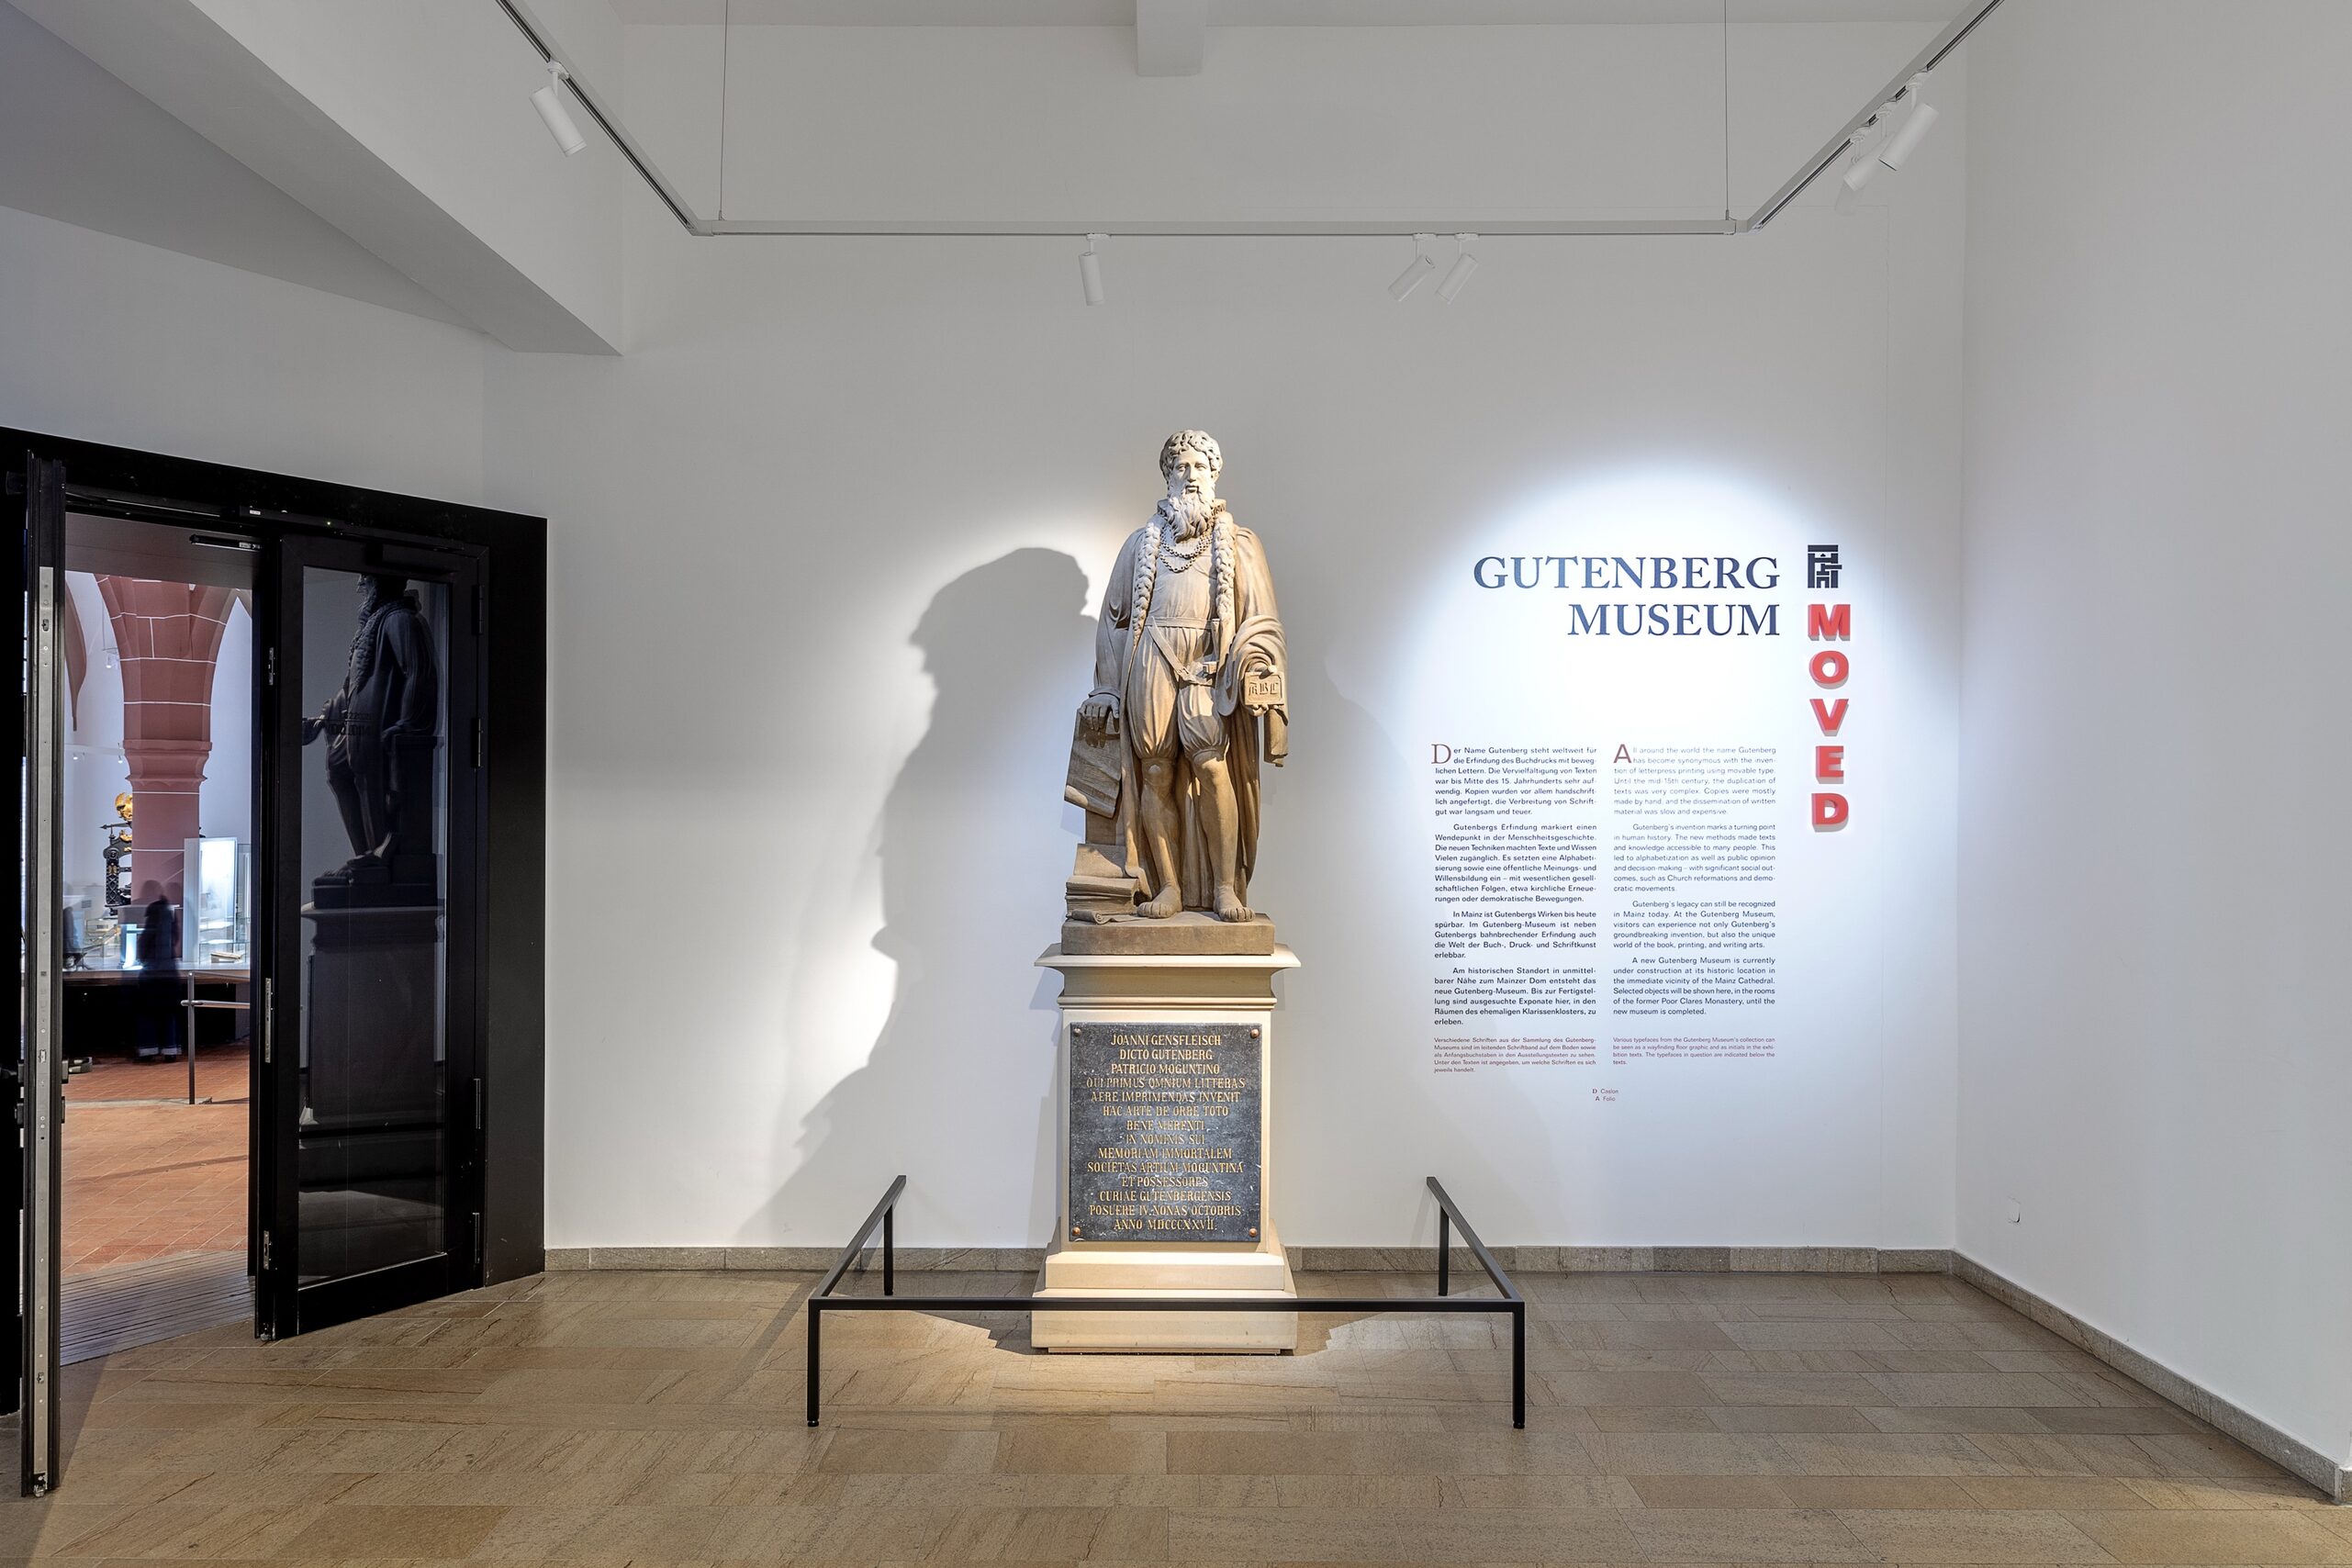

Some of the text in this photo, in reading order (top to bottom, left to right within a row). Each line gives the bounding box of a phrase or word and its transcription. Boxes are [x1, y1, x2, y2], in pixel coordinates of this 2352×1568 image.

[1474, 556, 1780, 588] GUTENBERG
[1568, 604, 1779, 635] MUSEUM
[1808, 604, 1851, 832] MOVED
[1488, 746, 1528, 756] Gutenberg
[1738, 745, 1776, 755] Gutenberg
[1494, 911, 1537, 919] Gutenbergs
[1434, 931, 1477, 940] Gutenbergs
[1541, 931, 1576, 939] Erfindung
[1658, 957, 1697, 966] Gutenberg
[1742, 957, 1775, 965] currently
[1613, 987, 1644, 995] Selected
[1644, 987, 1670, 996] objects
[1434, 998, 1450, 1006] lung
[1470, 998, 1517, 1006] ausgesuchte
[1518, 997, 1553, 1006] Exponate
[1661, 997, 1678, 1005] Poor
[1679, 996, 1703, 1005] Clares
[1434, 1007, 1464, 1015] Räumen
[1479, 1008, 1521, 1016] ehemaligen
[1111, 1035, 1221, 1046] JOANNI GENSFLEISCH
[1119, 1048, 1213, 1060] DICTO GUTENBERG
[1111, 1063, 1220, 1075] PATRICIO MOGUNTINO
[1106, 1077, 1145, 1089] PRIMUS
[1148, 1077, 1191, 1089] OMNIUM
[1091, 1092, 1240, 1103] AERE IMPRIMENDAS INVENIT
[1103, 1105, 1228, 1116] HAC ARTE DE ORBE TOTO
[1126, 1119, 1154, 1130] BENE
[1126, 1134, 1205, 1145] IN NOMINIS SUI
[1098, 1148, 1232, 1159] MEMORIAM IMMORTALEM
[1087, 1161, 1137, 1173] SOCIETAS
[1139, 1161, 1179, 1173] ARTIUM
[1121, 1176, 1208, 1187] ET POSSESSORES
[1099, 1191, 1231, 1202] CURIAE GUTENBERGENSIS
[1089, 1204, 1135, 1216] POSUERE
[1153, 1204, 1188, 1216] NONAS
[1191, 1204, 1241, 1216] OCTOBRIS
[1114, 1218, 1143, 1230] ANNO
